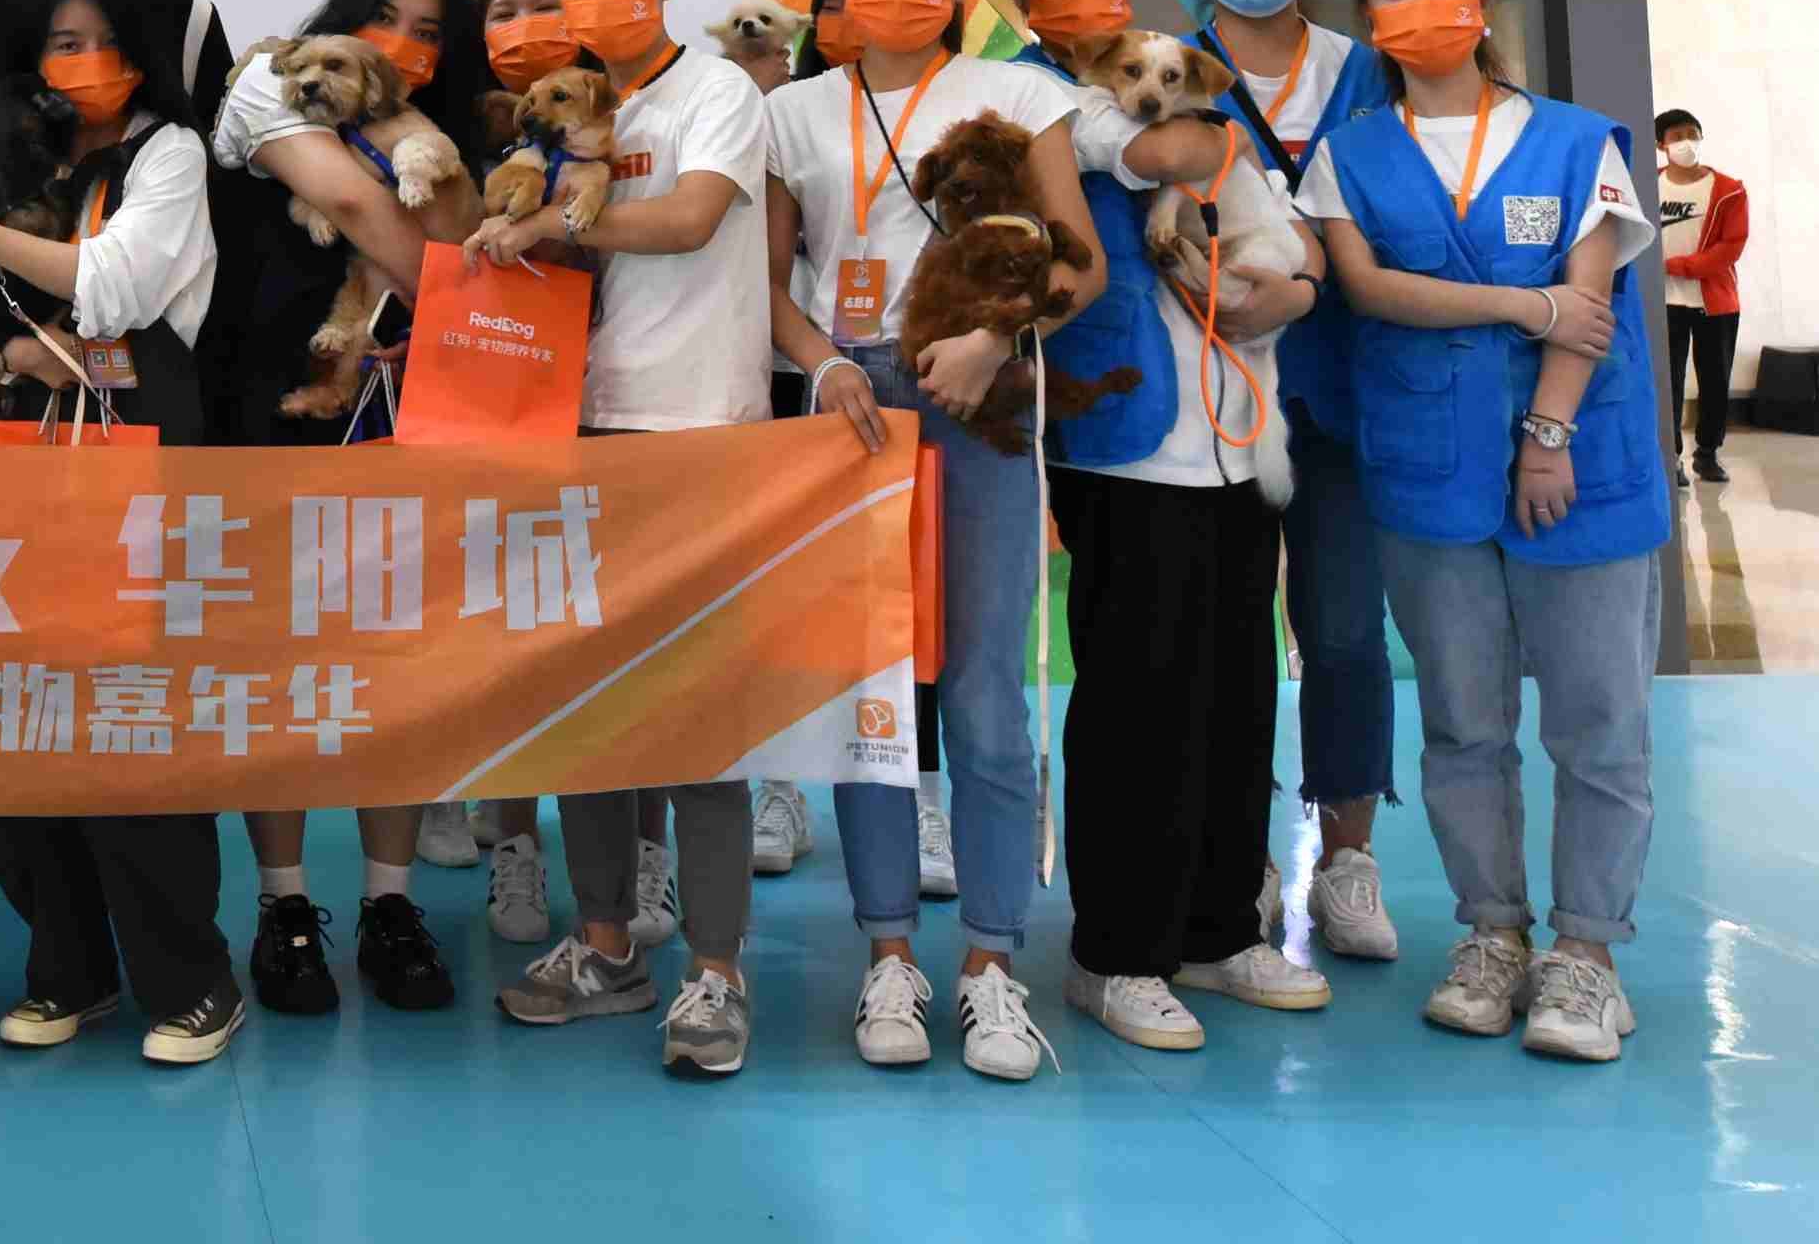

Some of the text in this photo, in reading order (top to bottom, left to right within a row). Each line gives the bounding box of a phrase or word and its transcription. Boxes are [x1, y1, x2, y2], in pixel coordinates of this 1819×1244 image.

[1660, 201, 1697, 218] NIKE
[469, 311, 535, 340] RedDog
[117, 485, 603, 637] 华阳城
